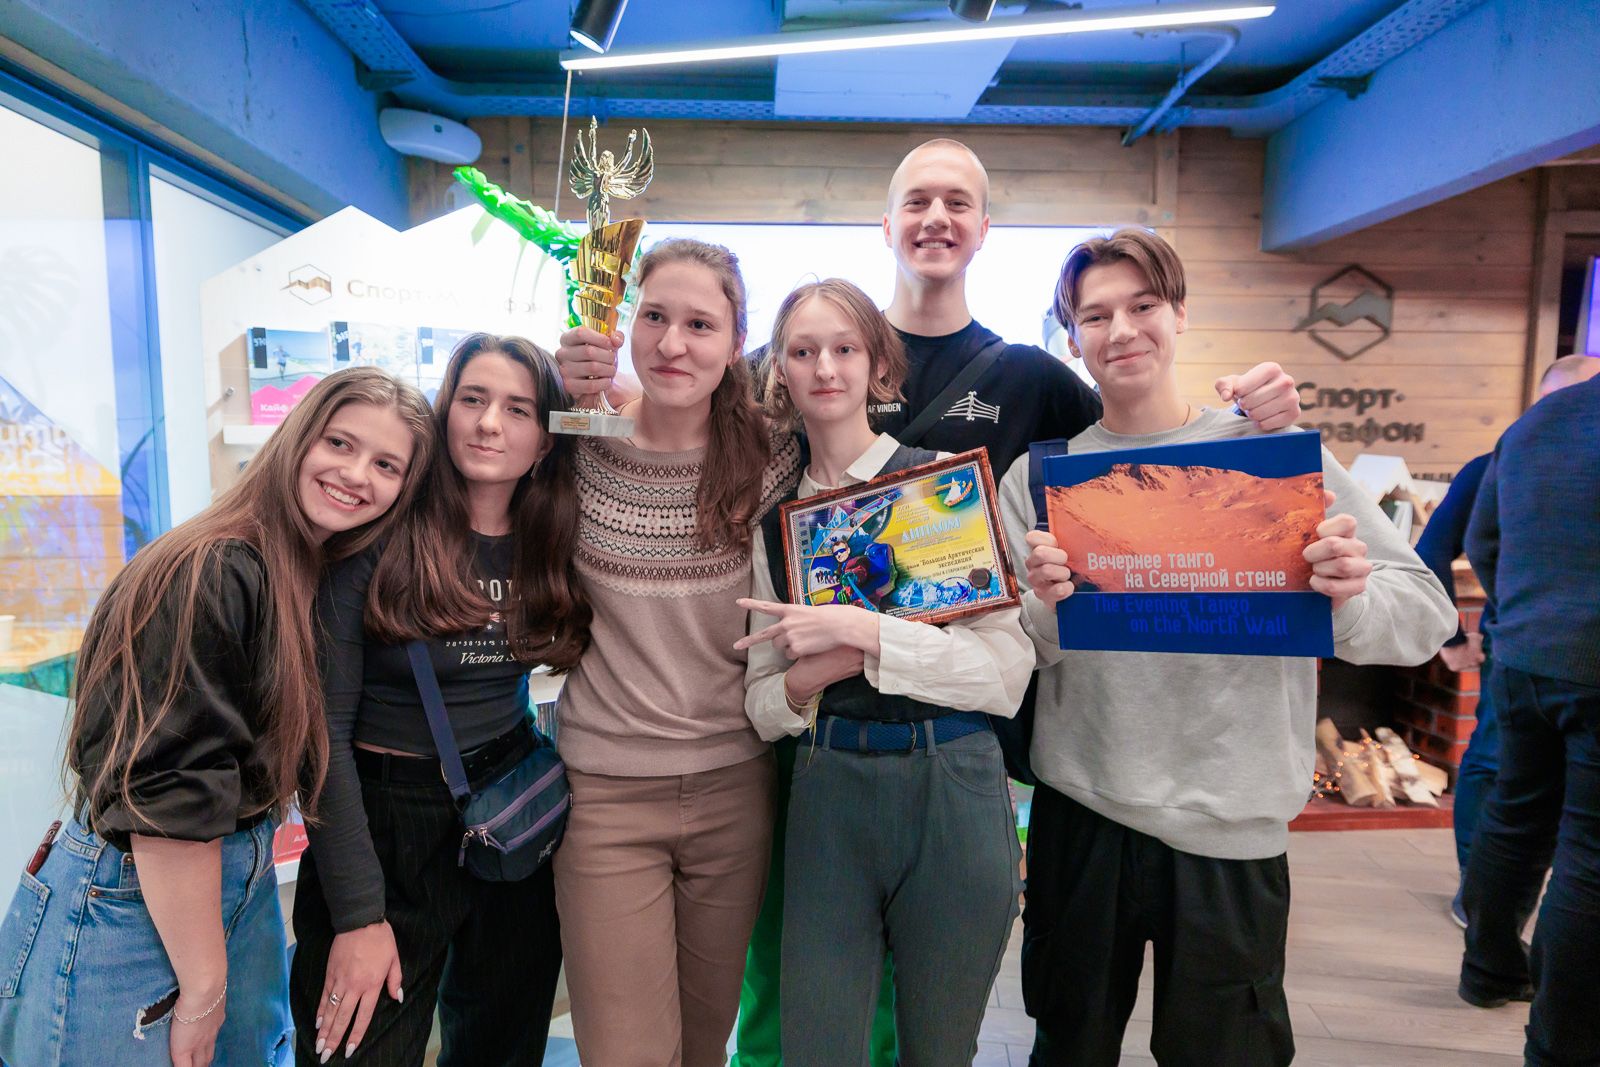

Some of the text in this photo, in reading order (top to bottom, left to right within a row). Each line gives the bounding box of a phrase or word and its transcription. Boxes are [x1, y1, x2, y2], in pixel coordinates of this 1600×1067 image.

[877, 403, 901, 413] VINDEN
[902, 517, 960, 543] ДИПЛОМ
[947, 547, 985, 561] Арктическая
[1087, 552, 1215, 571] Вечернее танго
[1125, 568, 1287, 592] на Северной стене
[1094, 596, 1250, 617] The Evening Tango
[1130, 615, 1289, 636] on the North Wall
[460, 651, 504, 665] Victoria
